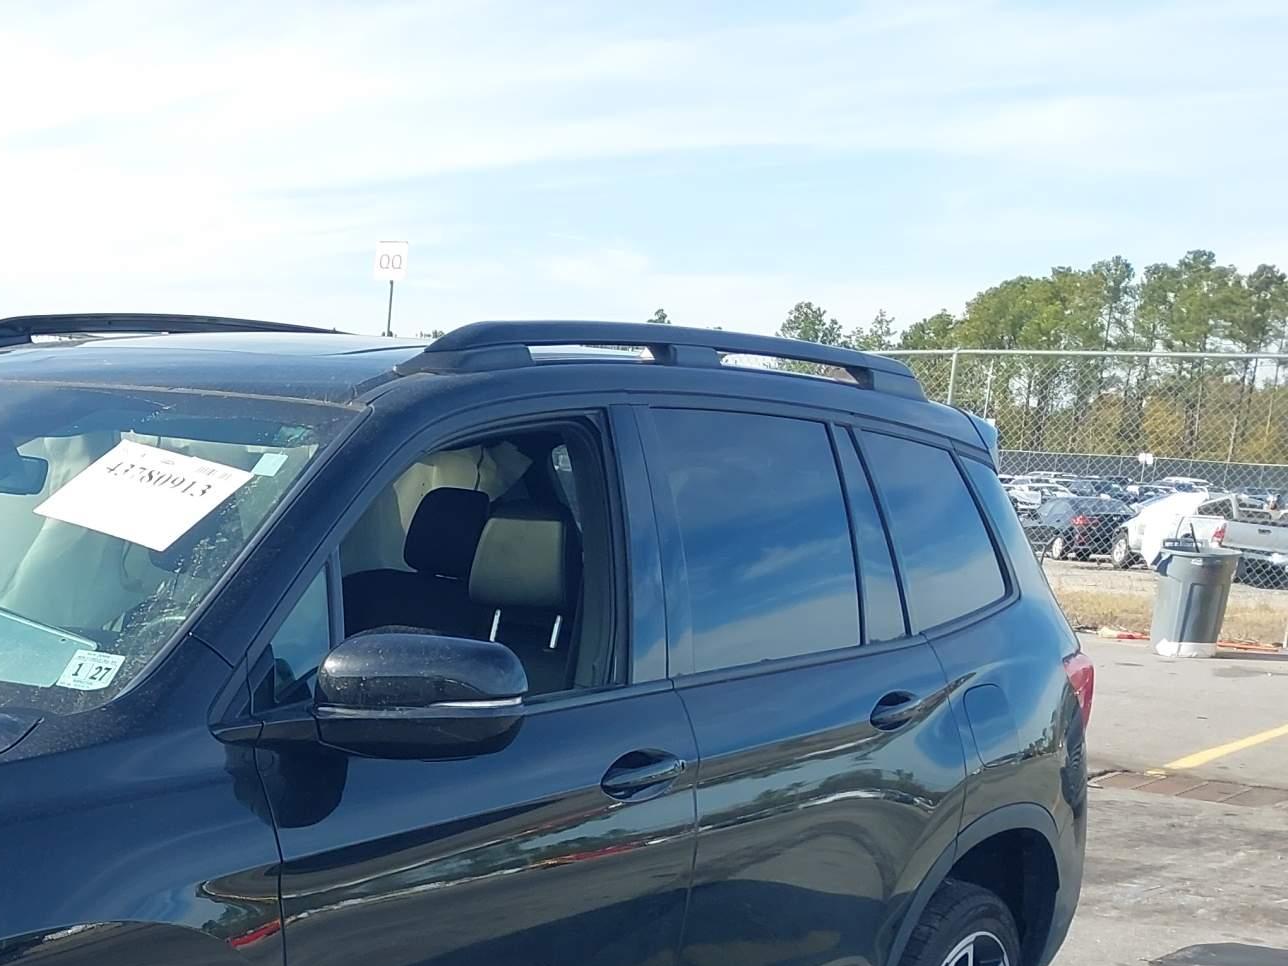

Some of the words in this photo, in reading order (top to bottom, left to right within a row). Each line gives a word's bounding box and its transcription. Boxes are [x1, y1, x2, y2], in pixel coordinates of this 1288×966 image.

[106, 462, 212, 496] 43780913
[72, 663, 84, 676] 1
[89, 666, 112, 681] 27
